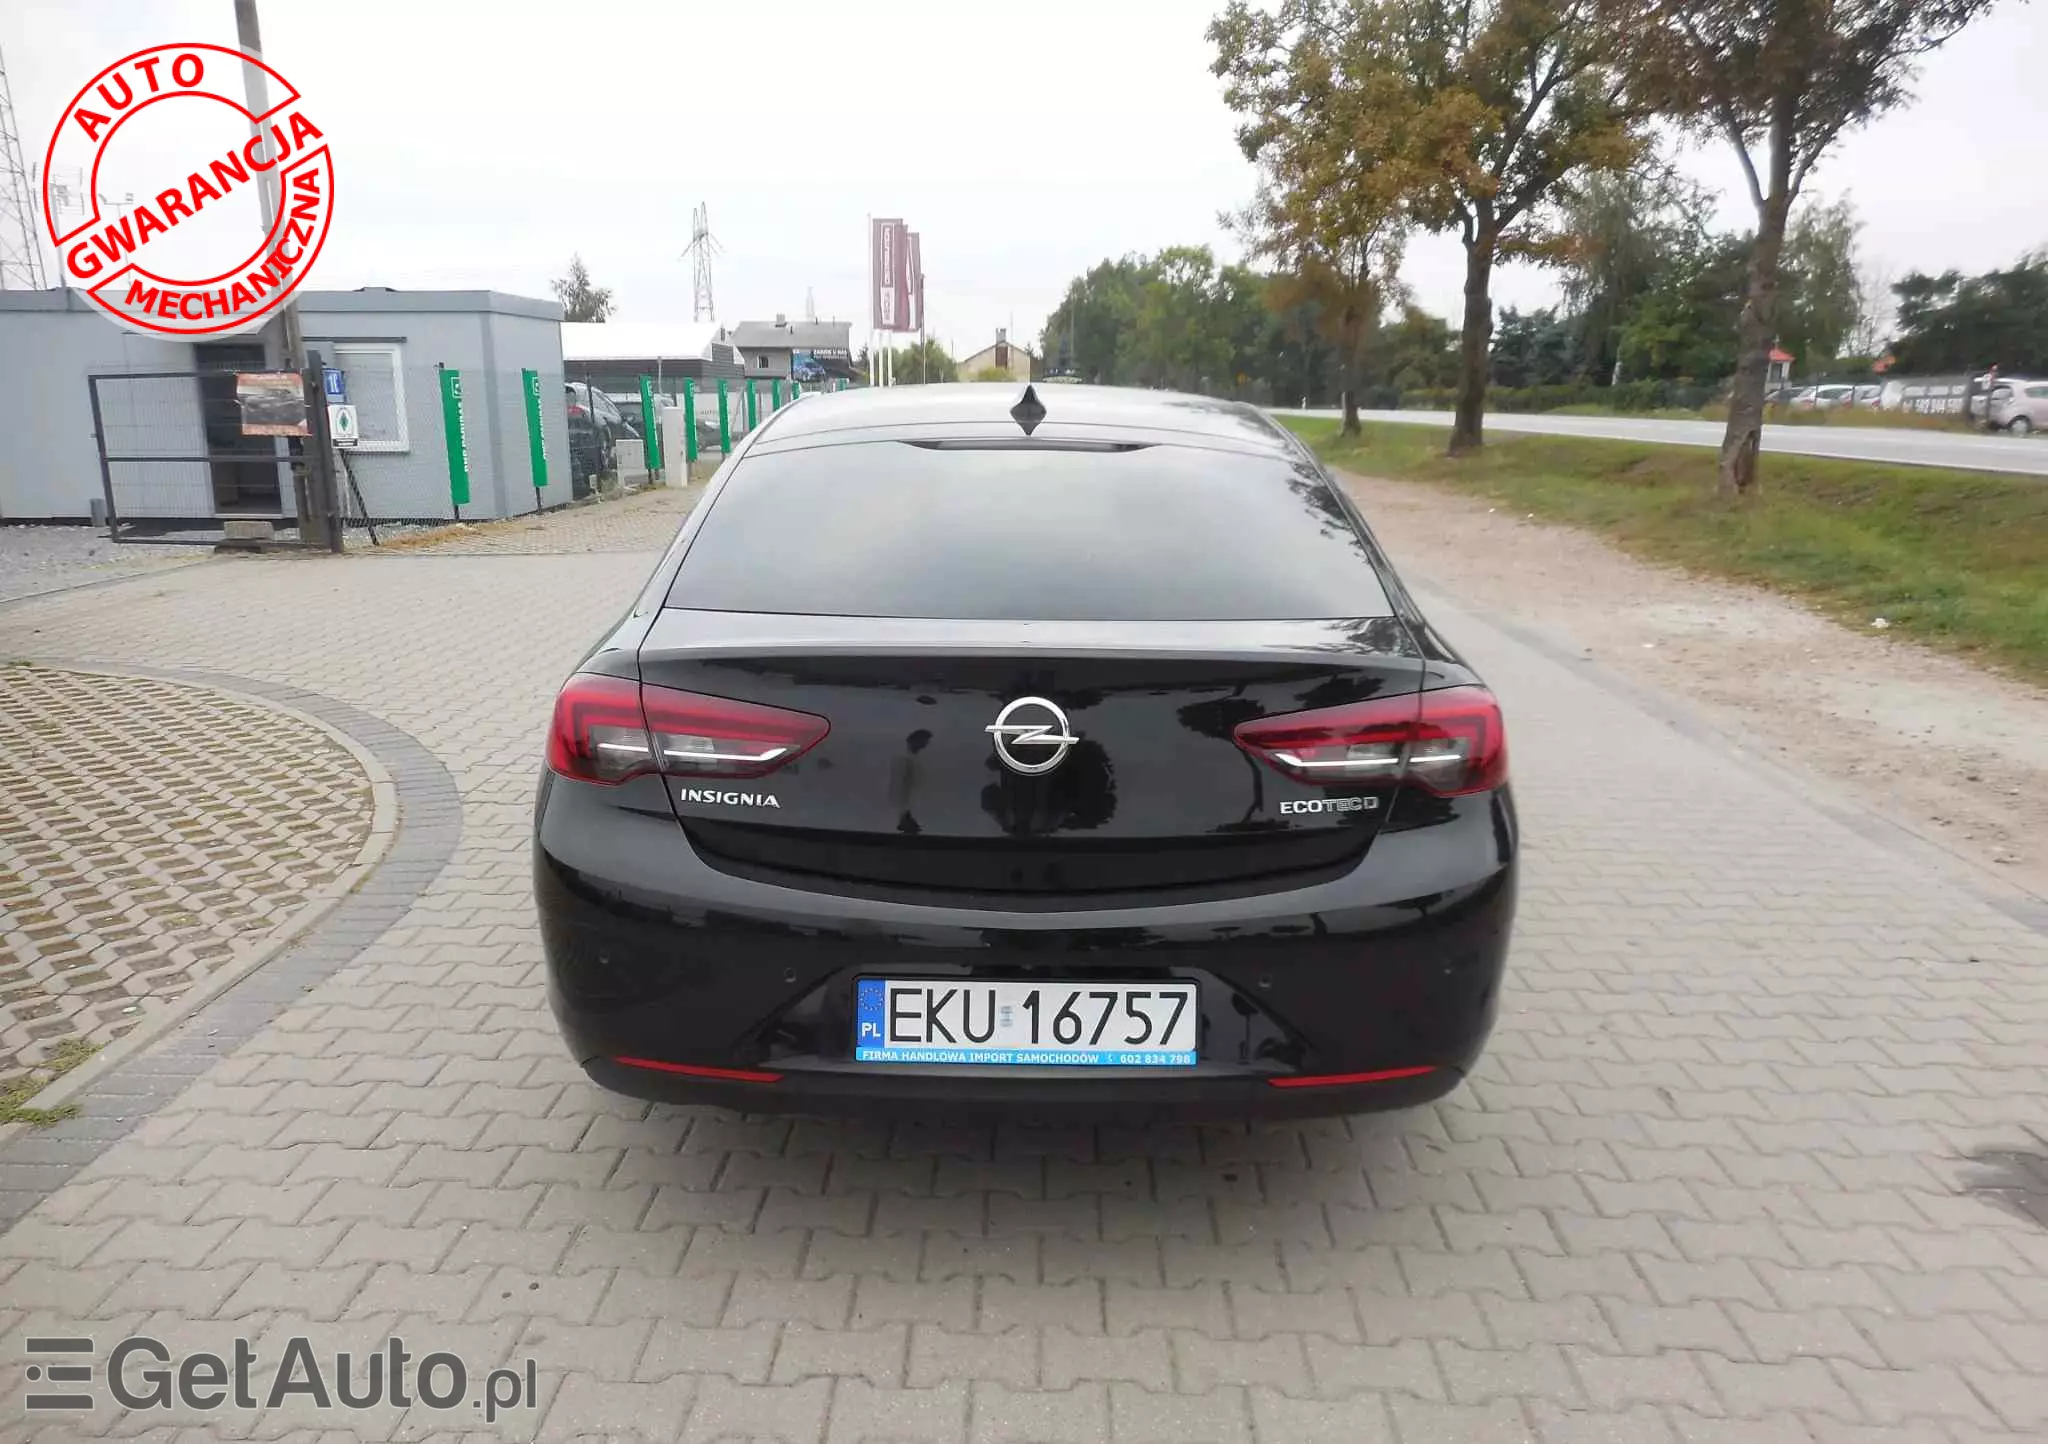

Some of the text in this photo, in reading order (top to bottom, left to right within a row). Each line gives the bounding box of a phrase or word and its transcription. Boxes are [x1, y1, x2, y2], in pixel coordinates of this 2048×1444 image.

[680, 788, 781, 809] INSIGNIA
[889, 987, 1189, 1046] EKU 16757
[861, 1022, 881, 1038] PL
[862, 1050, 898, 1061] FIRMA
[901, 1051, 967, 1062] HANDLOWA
[969, 1052, 1014, 1063] IMPORT
